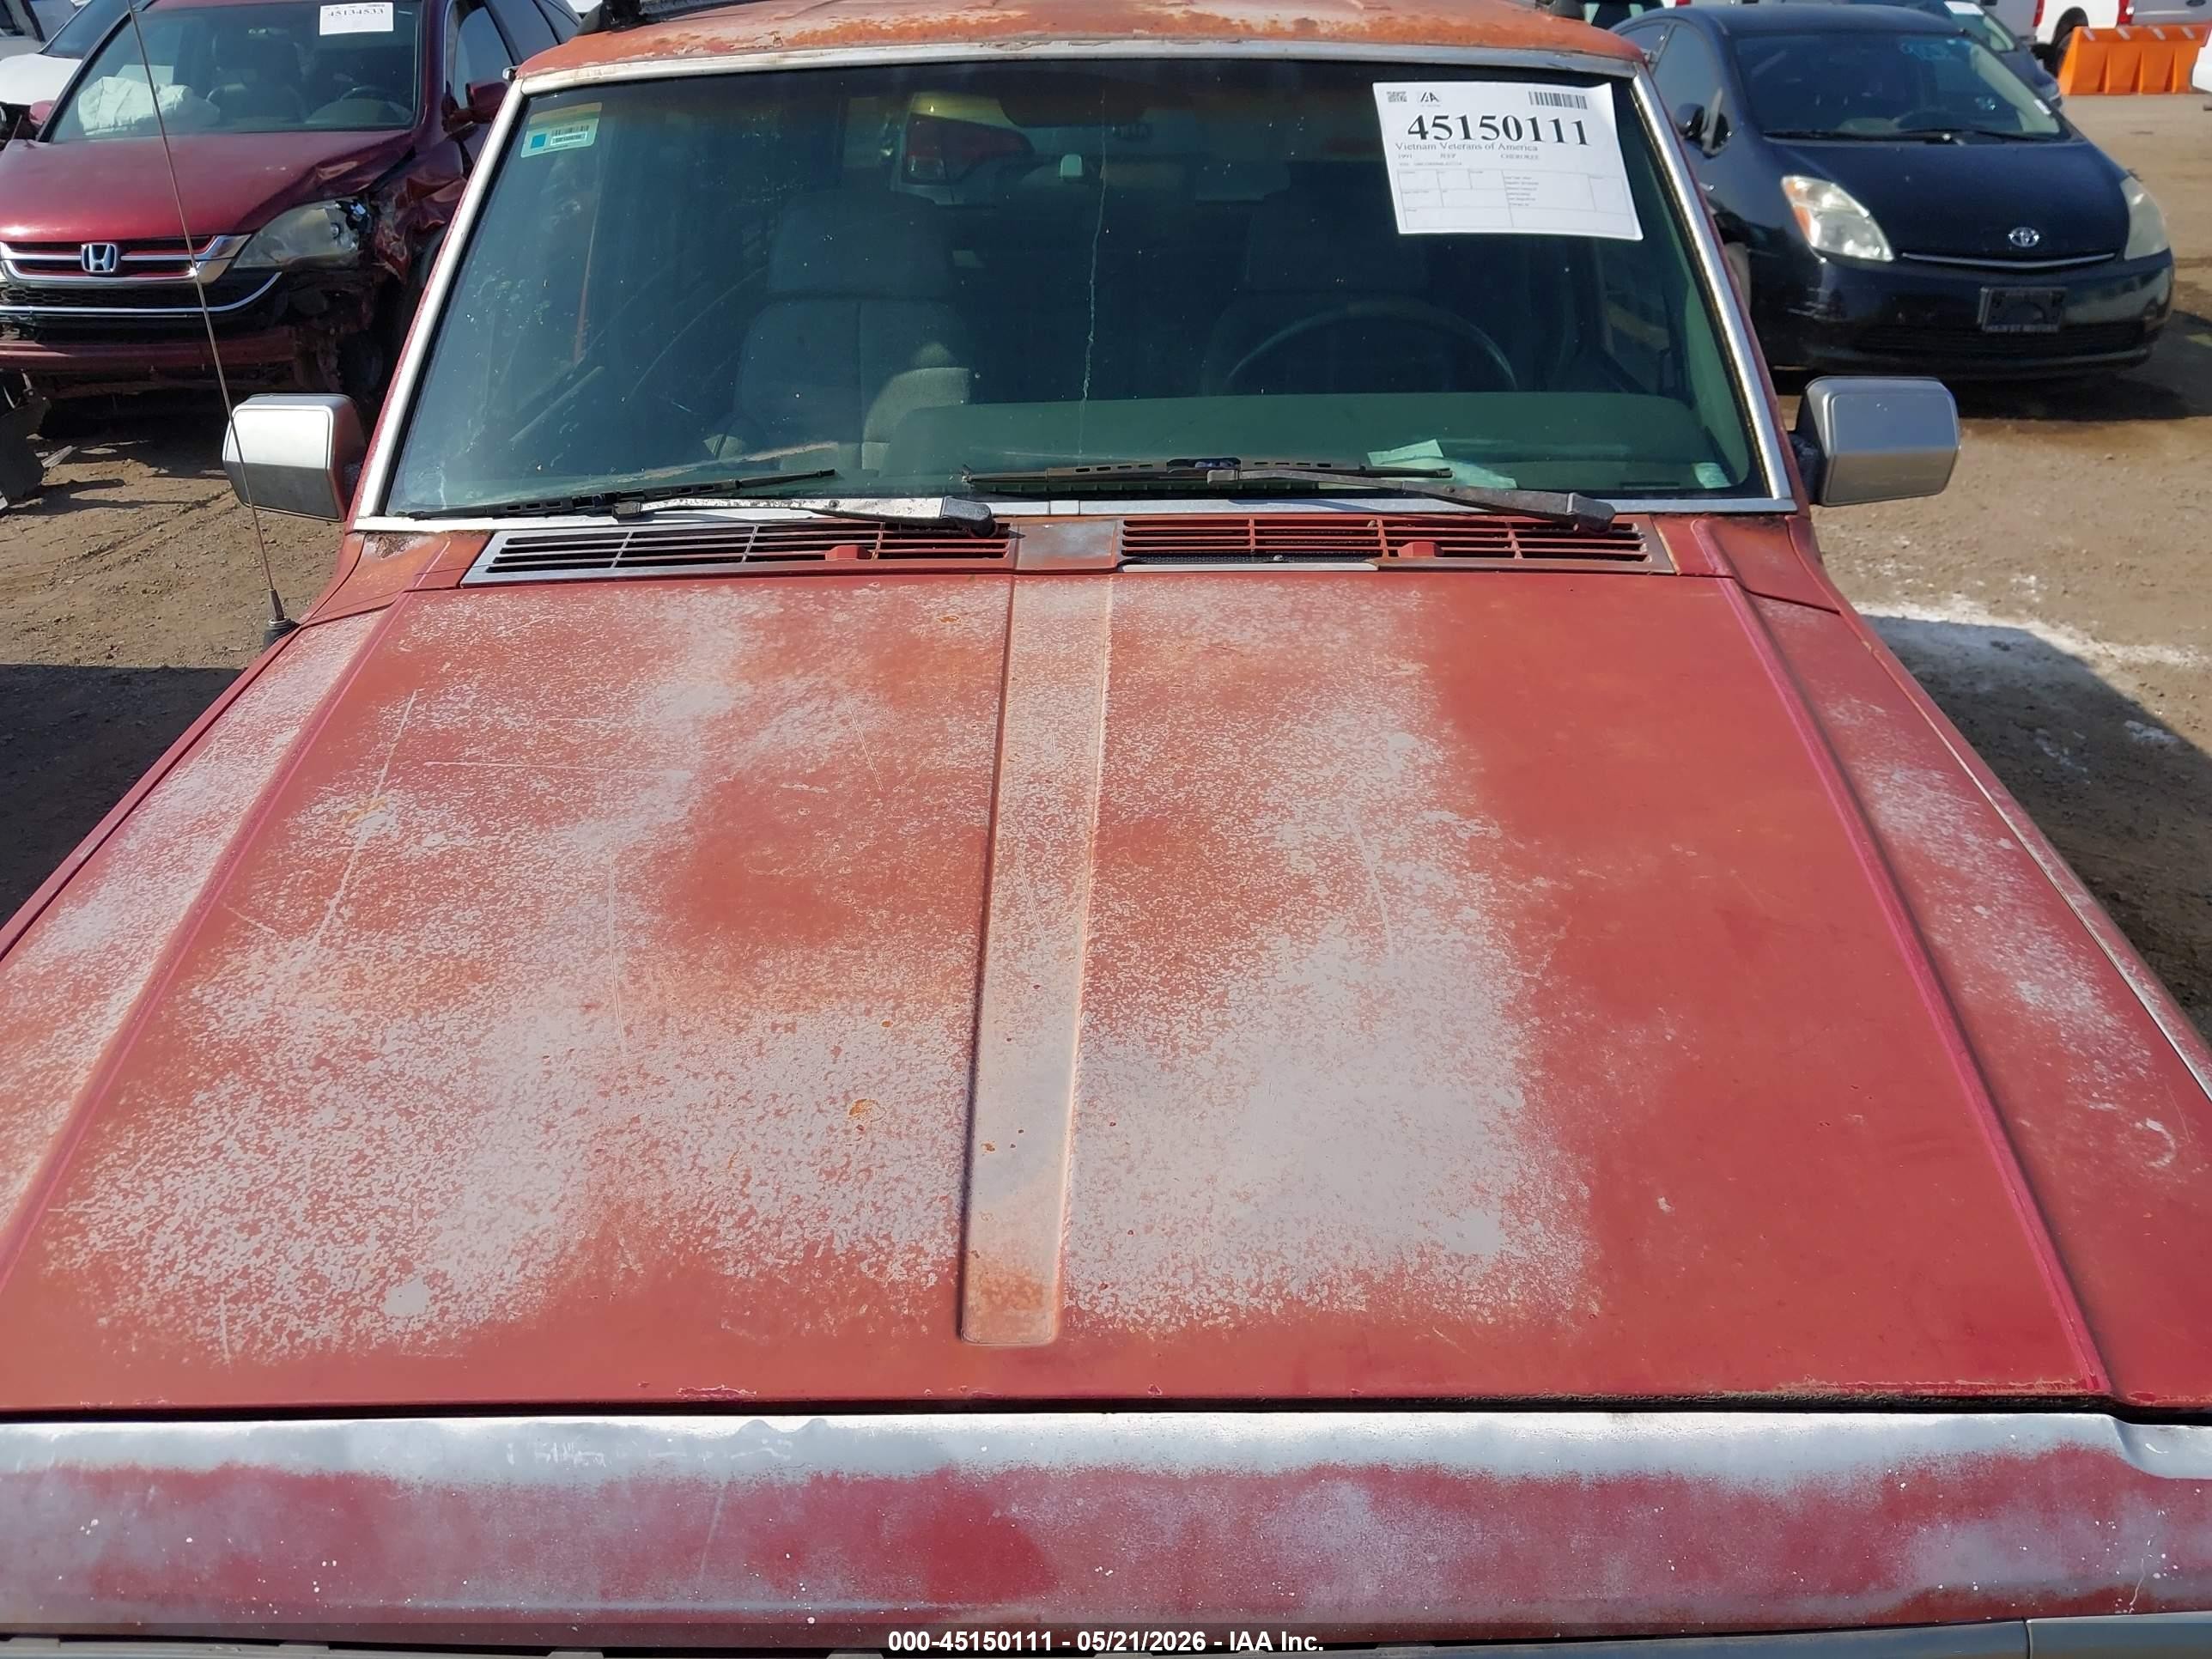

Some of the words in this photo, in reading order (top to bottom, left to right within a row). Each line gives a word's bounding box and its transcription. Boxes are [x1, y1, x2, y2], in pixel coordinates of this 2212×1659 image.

[1408, 114, 1591, 146] 45150111
[1485, 143, 1495, 151] of
[1498, 143, 1539, 152] America
